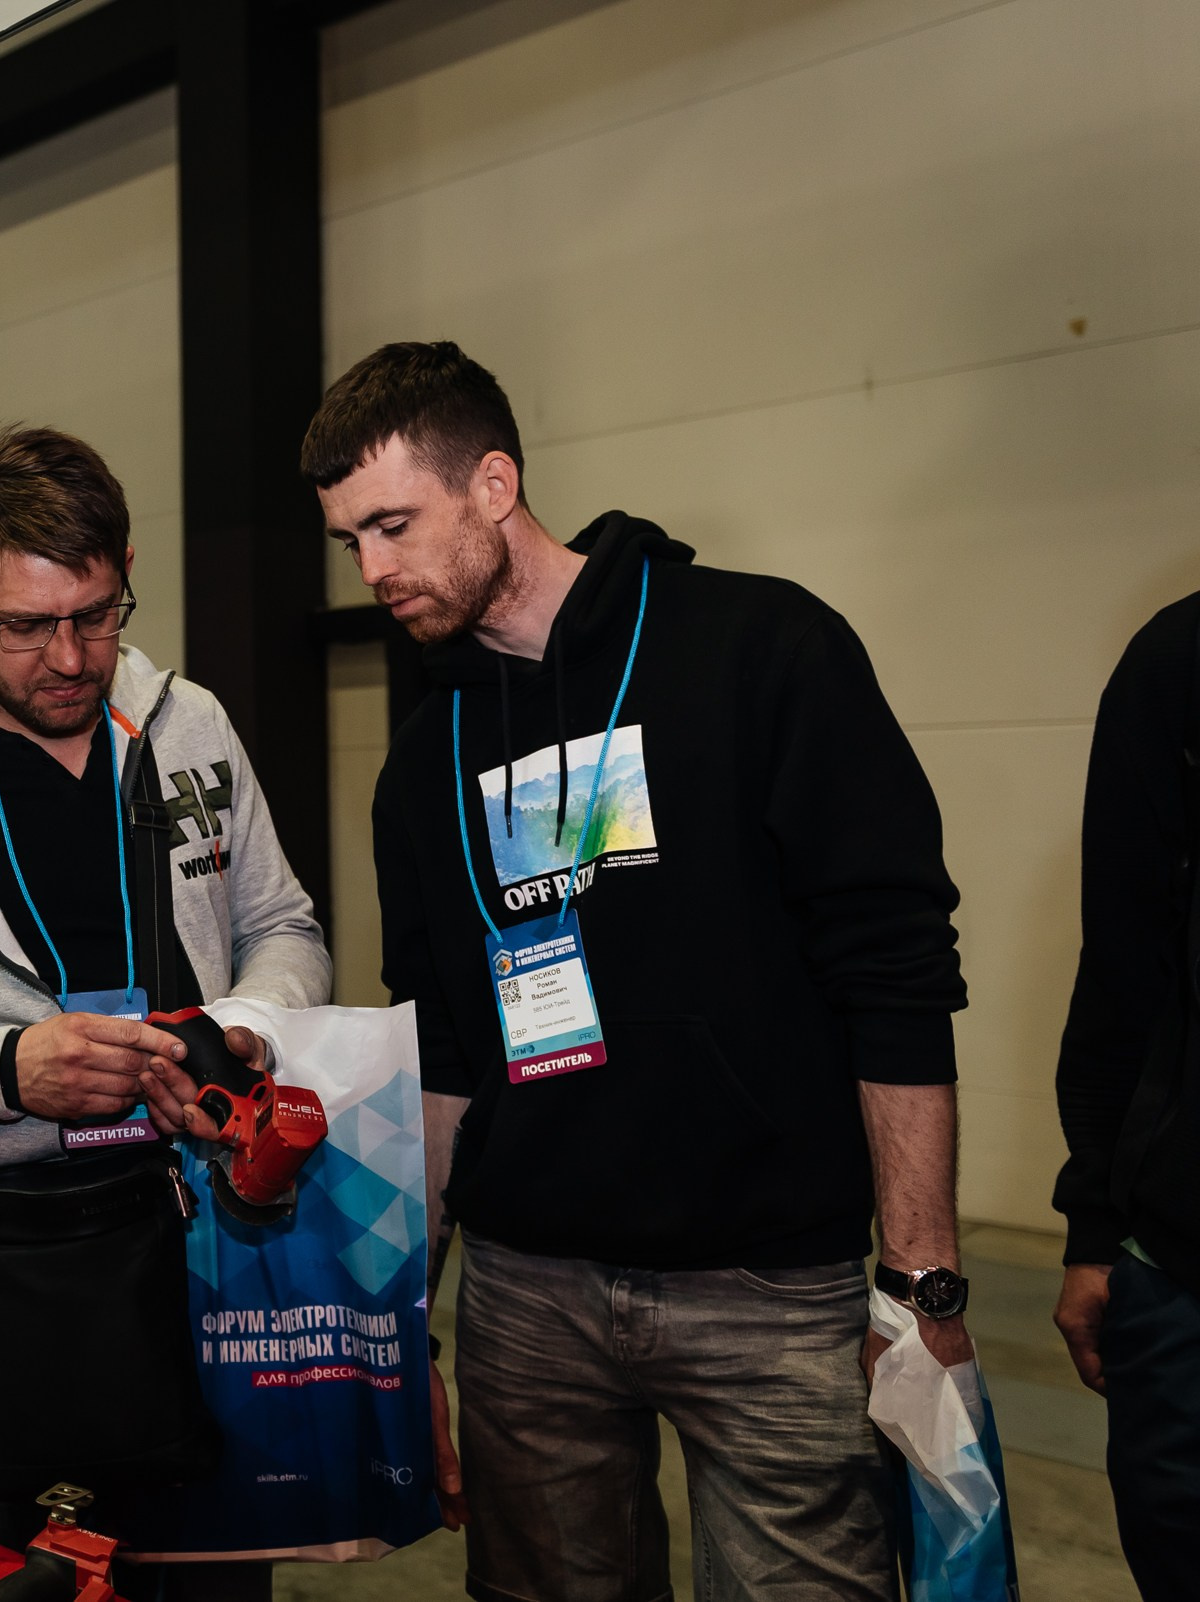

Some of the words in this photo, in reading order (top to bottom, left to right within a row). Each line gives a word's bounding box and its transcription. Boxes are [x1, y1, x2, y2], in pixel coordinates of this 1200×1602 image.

[504, 878, 552, 911] OFF
[552, 862, 596, 899] PATH
[529, 967, 561, 982] НОСИКОВ
[536, 980, 558, 989] Роман
[531, 987, 568, 1001] Вадимович
[577, 1031, 596, 1041] iPRO
[511, 1047, 527, 1057] ЭТМ
[521, 1052, 593, 1077] ПОСЕТИТЕЛЬ
[278, 1102, 322, 1115] FUEL
[67, 1126, 146, 1143] ПОСЕТИТЕЛЬ
[202, 1310, 265, 1335] ФОРУМ
[270, 1304, 398, 1338] ЭЛЕКТРОТЕХНИКИ
[202, 1340, 213, 1364] И
[219, 1333, 334, 1364] ИНЖЕНЕРНЫХ
[341, 1333, 401, 1368] СИСТЕМ
[256, 1373, 287, 1386] для
[290, 1366, 401, 1390] профессионалов
[256, 1473, 309, 1483] skills.etm.ru
[371, 1457, 414, 1485] iPRO
